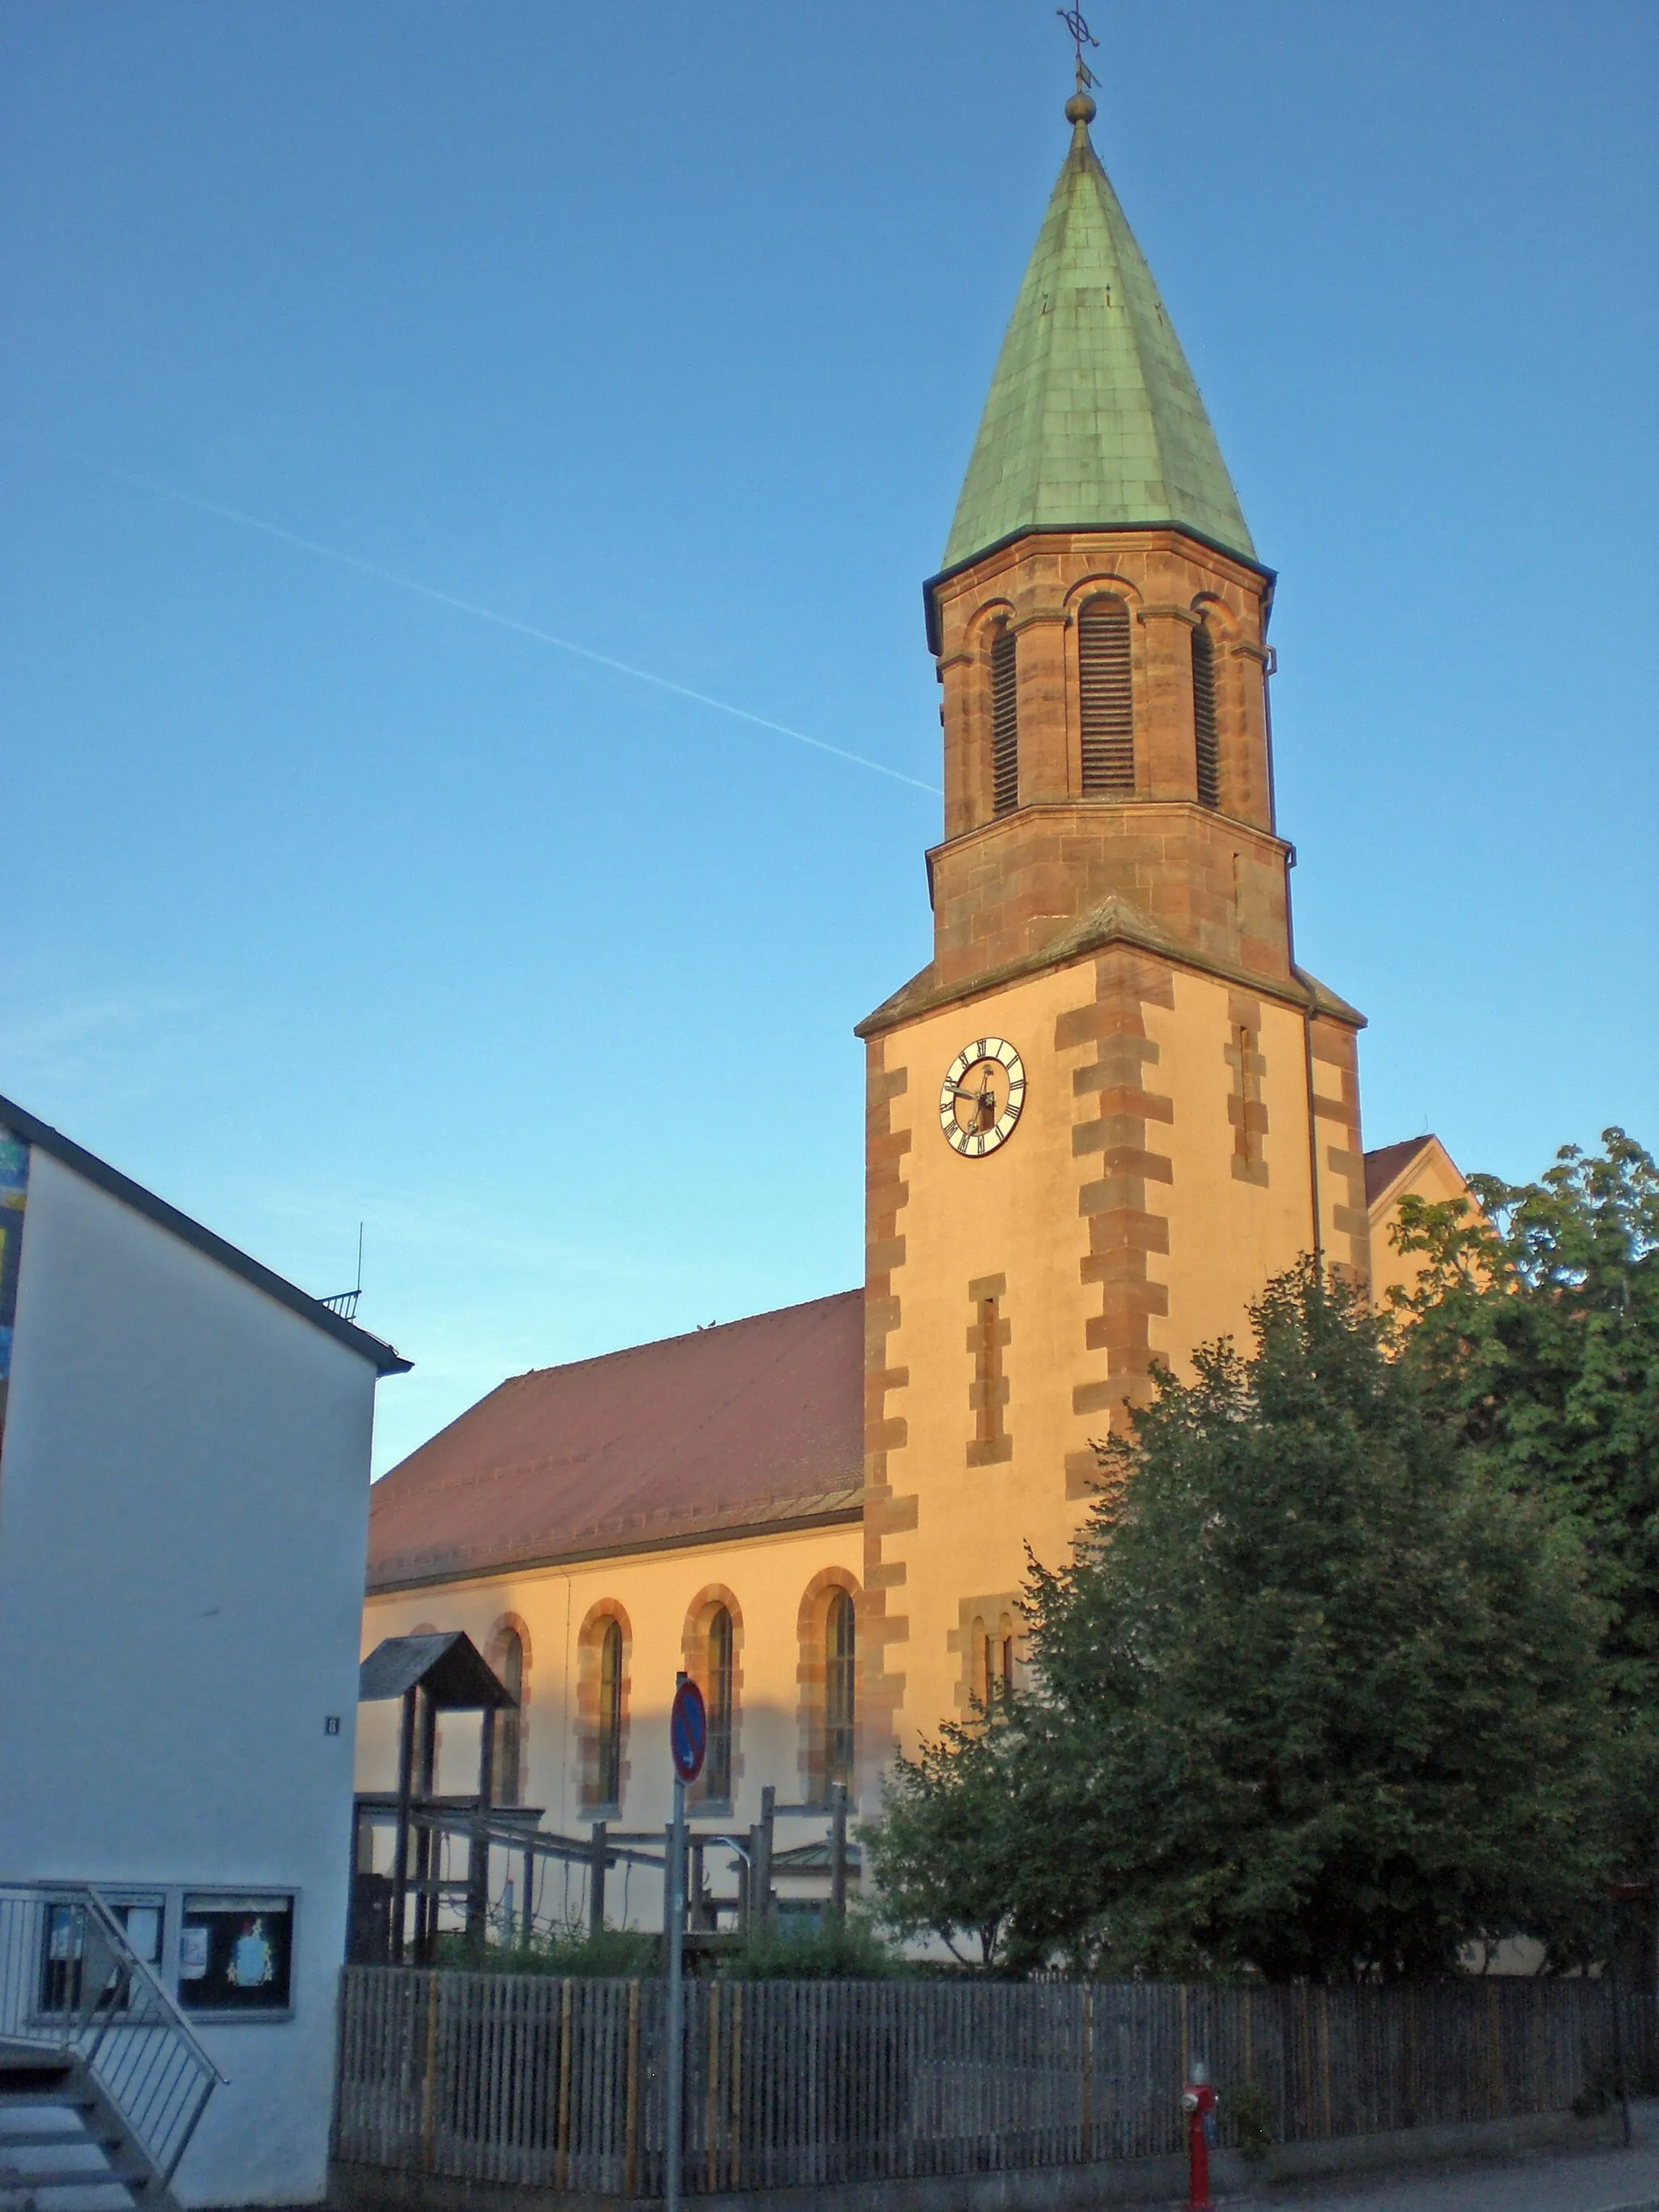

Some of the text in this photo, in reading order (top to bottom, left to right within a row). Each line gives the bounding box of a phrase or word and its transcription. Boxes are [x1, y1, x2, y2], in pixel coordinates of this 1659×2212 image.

[977, 1038, 987, 1058] XII
[996, 1041, 1004, 1058] I
[958, 1051, 970, 1070] XI
[1006, 1055, 1020, 1070] II
[1009, 1079, 1025, 1092] III
[940, 1102, 954, 1114] IX
